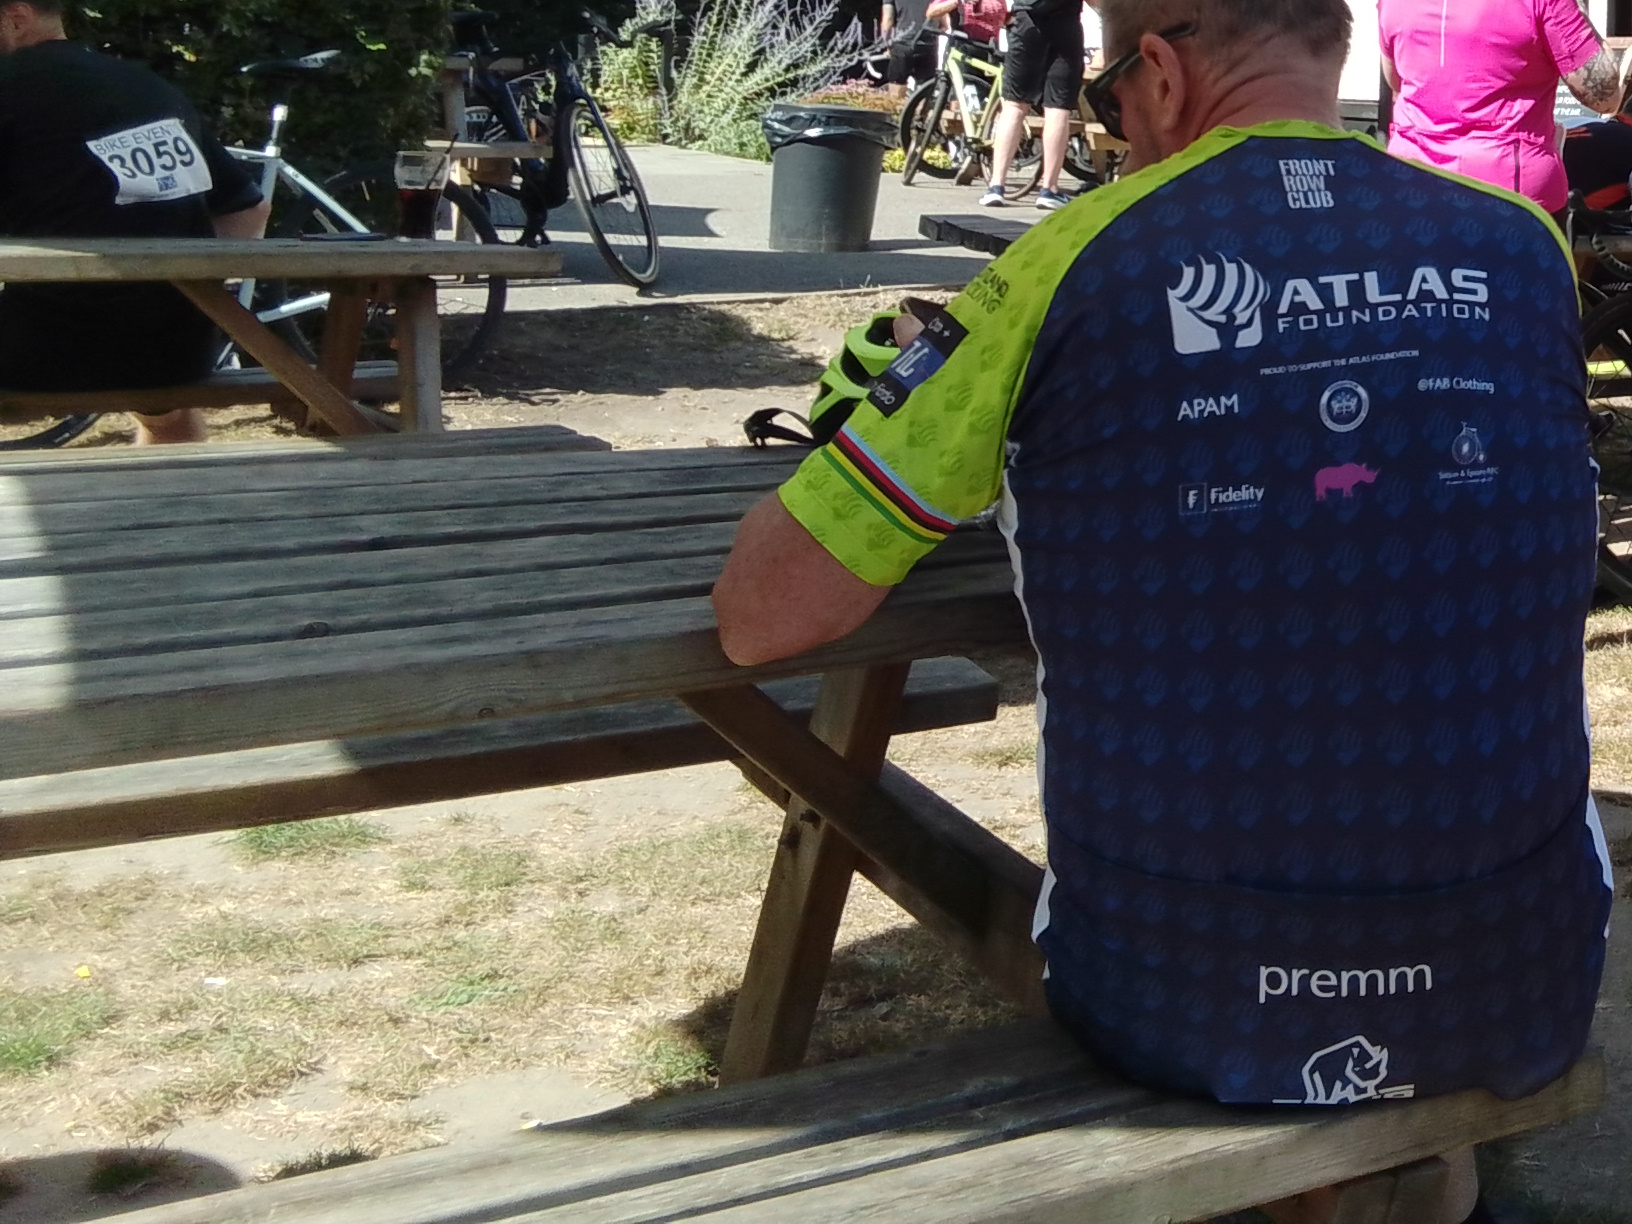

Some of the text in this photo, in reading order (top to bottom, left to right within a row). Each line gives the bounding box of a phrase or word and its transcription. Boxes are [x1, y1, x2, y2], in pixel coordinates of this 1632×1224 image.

[94, 136, 131, 156] BIKE
[107, 136, 195, 180] 3059
[1278, 158, 1336, 177] FRONT
[1283, 175, 1325, 192] ROW
[1286, 191, 1335, 209] CLUB
[1276, 267, 1489, 314] ATLAS
[1277, 303, 1491, 334] FOUNDATION
[1333, 358, 1347, 367] THE
[1348, 354, 1371, 365] ATLAS
[1371, 349, 1419, 362] FOUNDATION
[1452, 376, 1495, 394] Clothing
[1177, 393, 1239, 421] APAM
[1210, 483, 1265, 505] Fidelity
[1258, 963, 1433, 1004] premm
